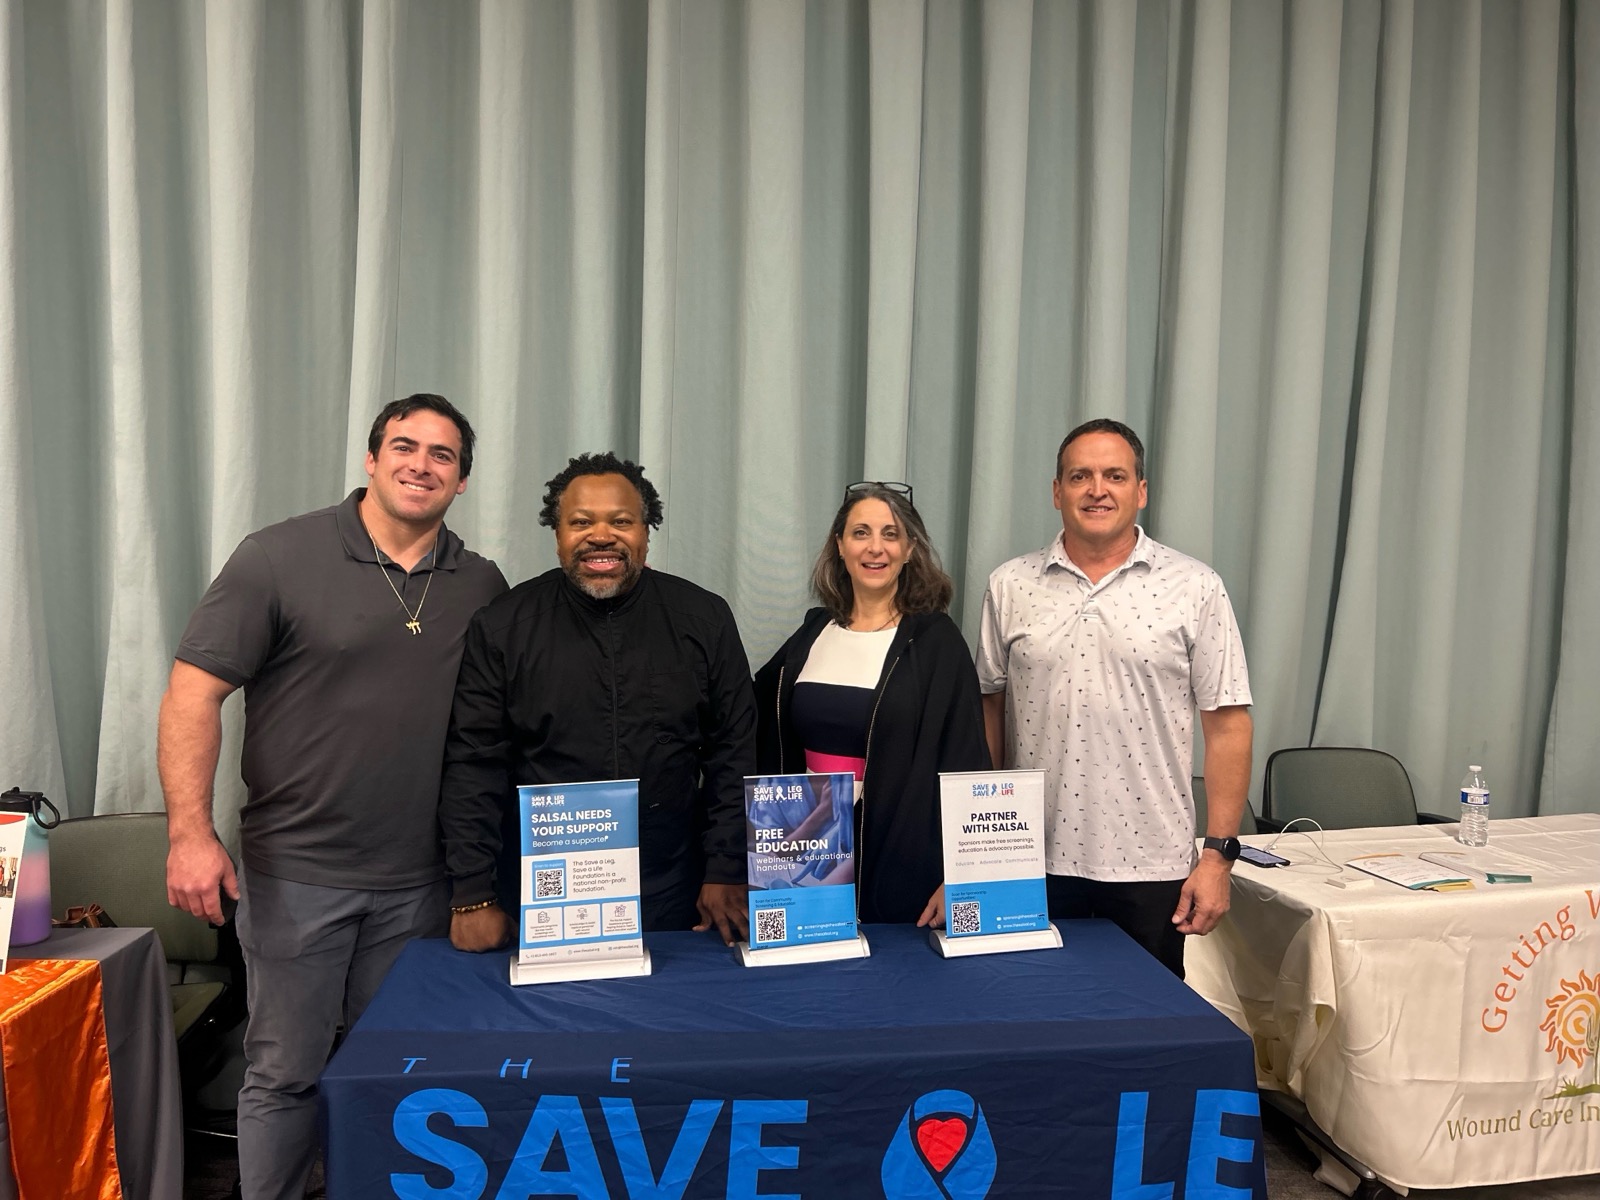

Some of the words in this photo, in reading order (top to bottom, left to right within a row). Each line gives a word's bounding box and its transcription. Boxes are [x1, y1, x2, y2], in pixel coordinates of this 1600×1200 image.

[753, 786, 774, 795] SAVE
[787, 785, 803, 793] LEG
[972, 783, 990, 791] SAVE
[753, 794, 774, 802] SAVE
[787, 792, 803, 800] LIFE
[531, 811, 574, 824] SALSAL
[575, 808, 612, 820] NEEDS
[970, 811, 1018, 822] PARTNER
[531, 826, 564, 837] YOUR
[566, 822, 619, 834] SUPPORT
[755, 828, 784, 840] FREE
[962, 823, 990, 834] WITH
[991, 822, 1030, 833] SALSAL
[532, 838, 564, 848] Become
[755, 838, 829, 854] EDUCATION
[958, 846, 984, 854] education
[988, 845, 1014, 854] advocacy
[756, 855, 794, 864] webinars
[804, 852, 853, 862] educational
[756, 863, 796, 872] handouts
[572, 872, 606, 880] Foundation
[572, 879, 597, 887] national
[597, 877, 627, 886] non-profit
[1481, 904, 1576, 1033] Getting
[402, 1057, 633, 1083] THE
[1447, 1109, 1522, 1142] Wound
[1529, 1108, 1574, 1129] Care
[390, 1088, 809, 1200] SAVE
[1111, 1089, 1261, 1200] LE
